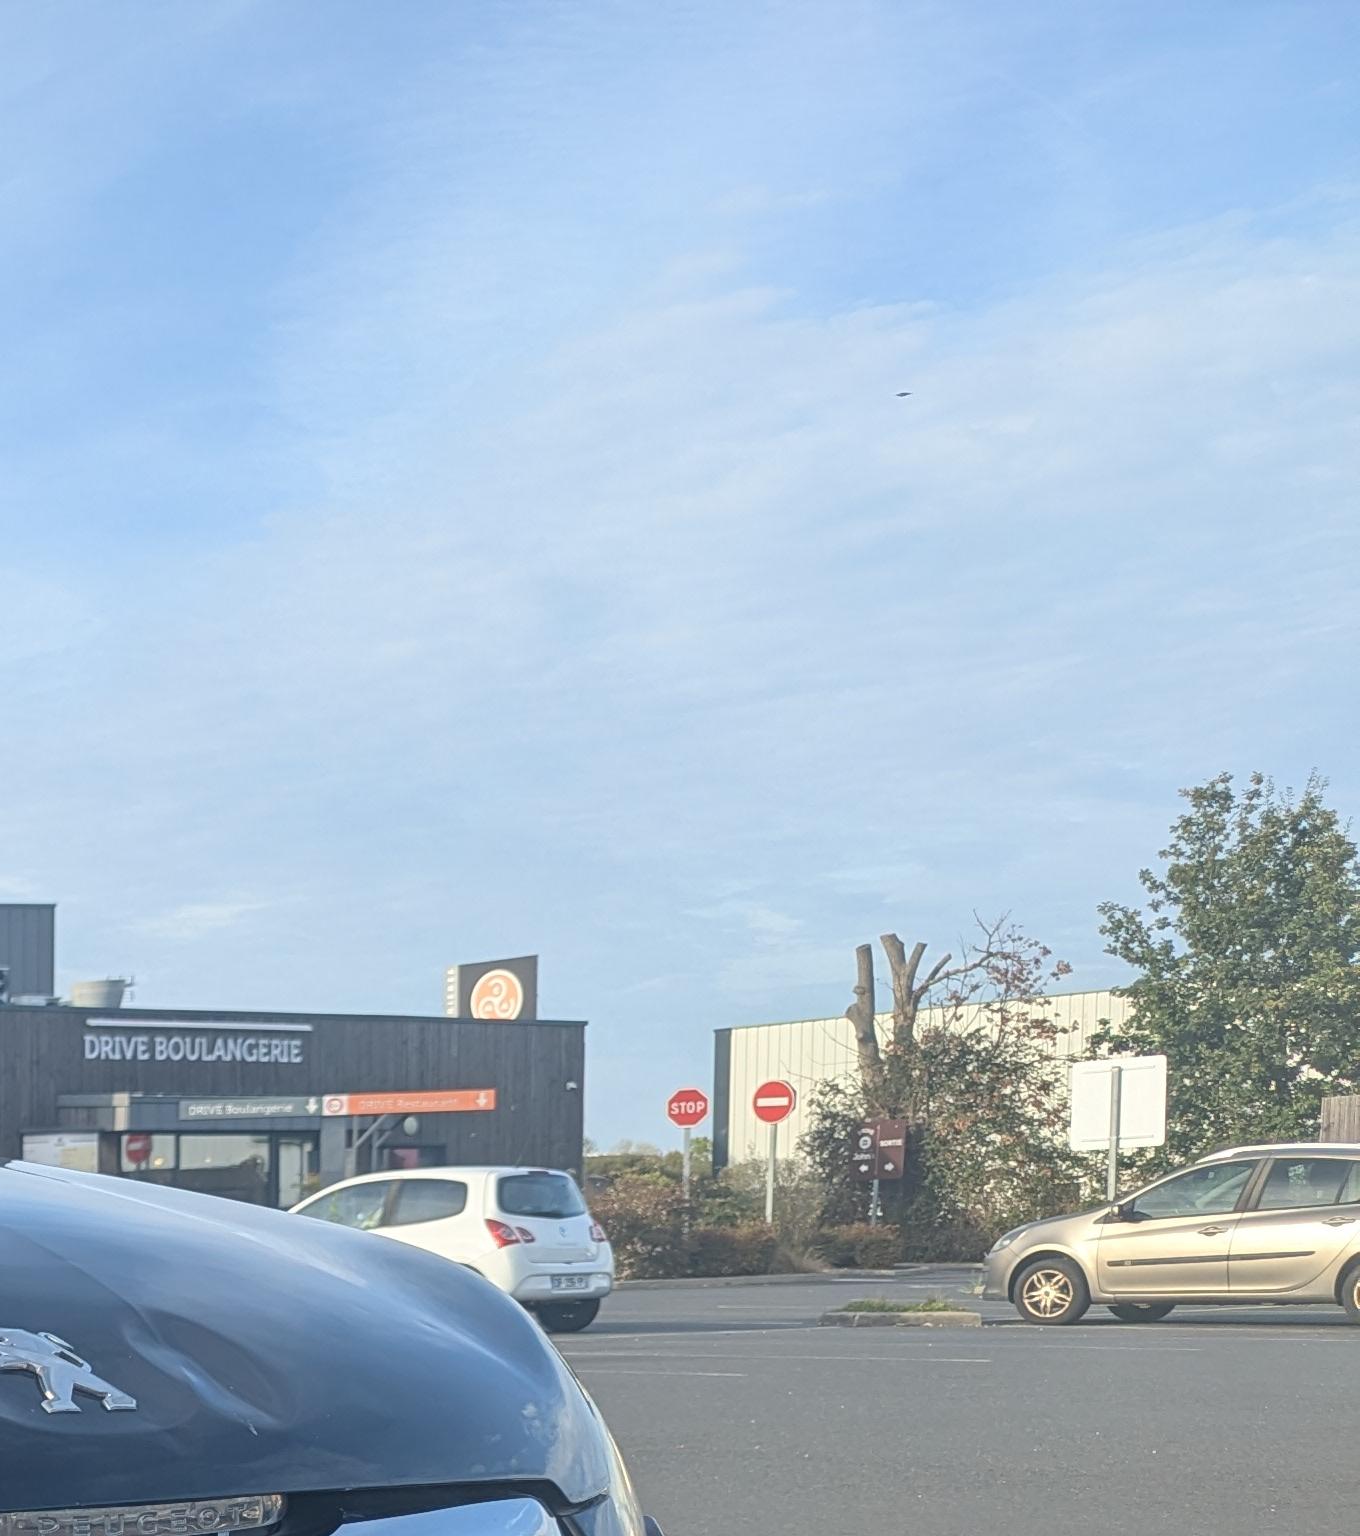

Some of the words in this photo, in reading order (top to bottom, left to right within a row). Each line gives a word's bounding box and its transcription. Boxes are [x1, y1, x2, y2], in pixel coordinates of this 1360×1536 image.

[84, 1035, 150, 1061] DRIVE
[154, 1037, 304, 1063] BOULANGERIE
[188, 1103, 224, 1116] DRIVE
[670, 1101, 706, 1115] STOP
